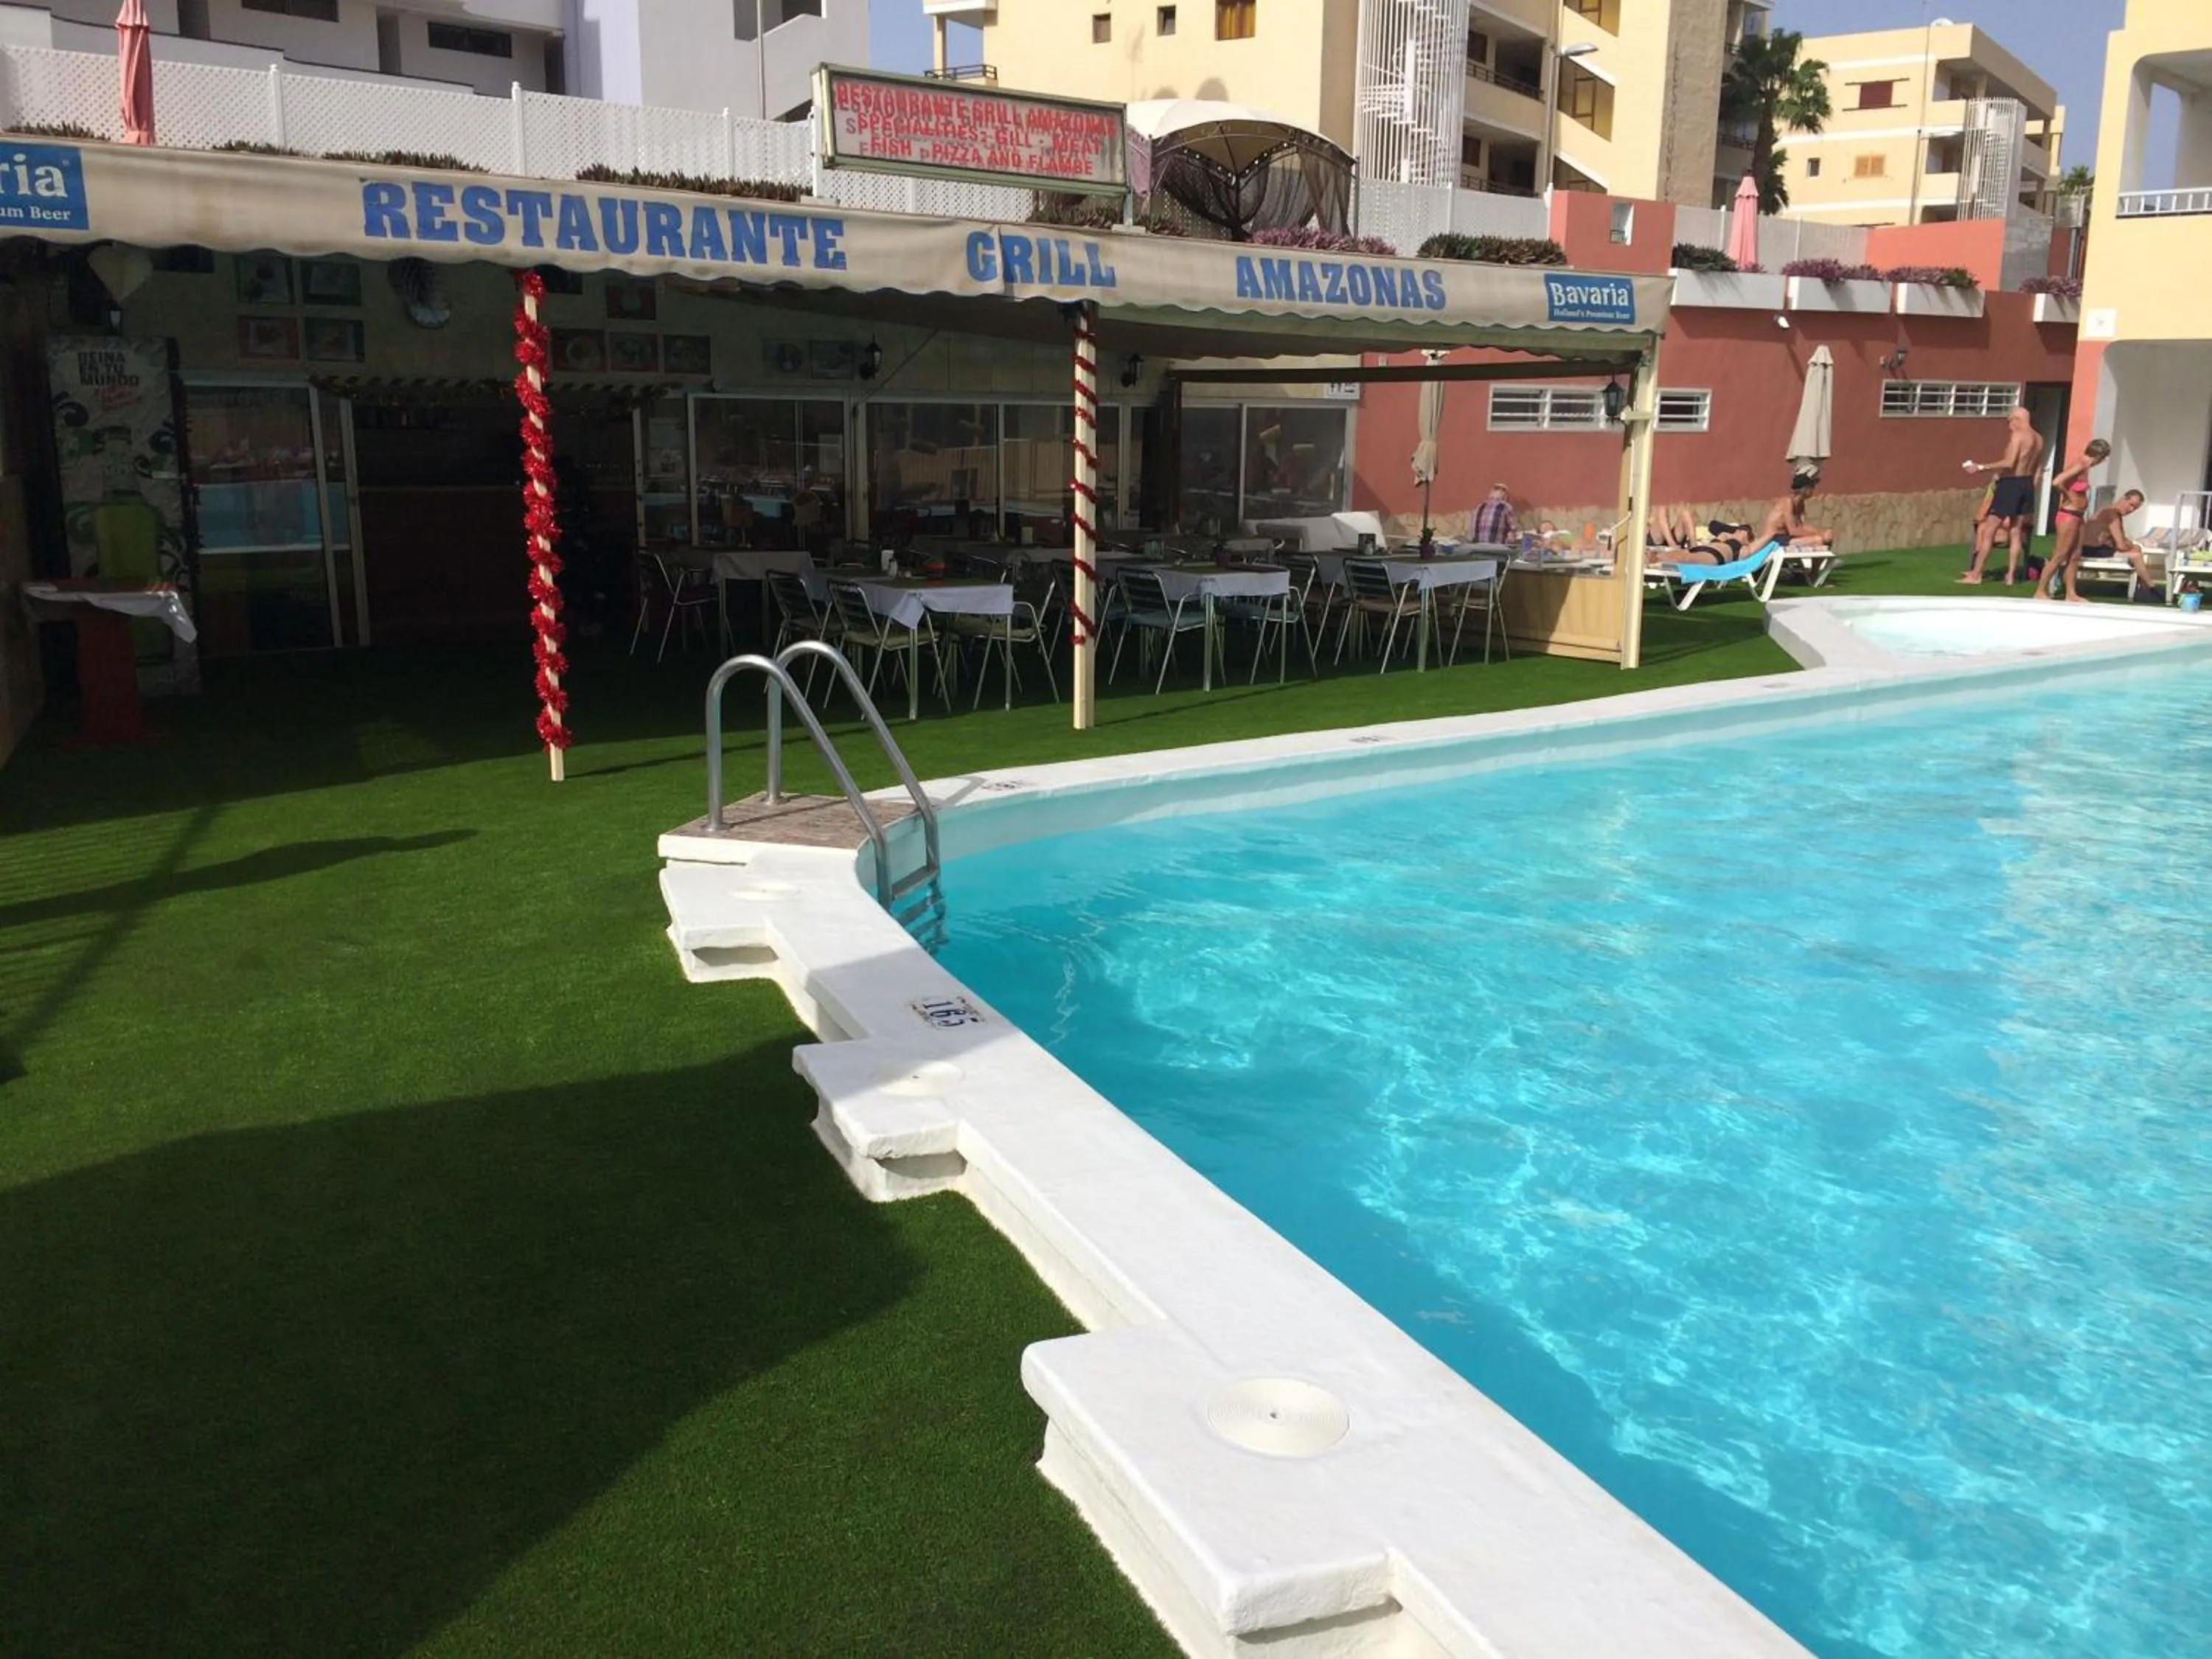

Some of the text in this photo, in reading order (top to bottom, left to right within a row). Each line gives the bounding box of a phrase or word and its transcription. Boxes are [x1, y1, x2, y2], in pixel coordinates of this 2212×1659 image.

[987, 148, 1022, 167] AND
[29, 206, 71, 220] Beer
[361, 181, 1447, 311] RESTAURANTE GRILL AMAZONAS
[1549, 282, 1628, 307] Bavaria
